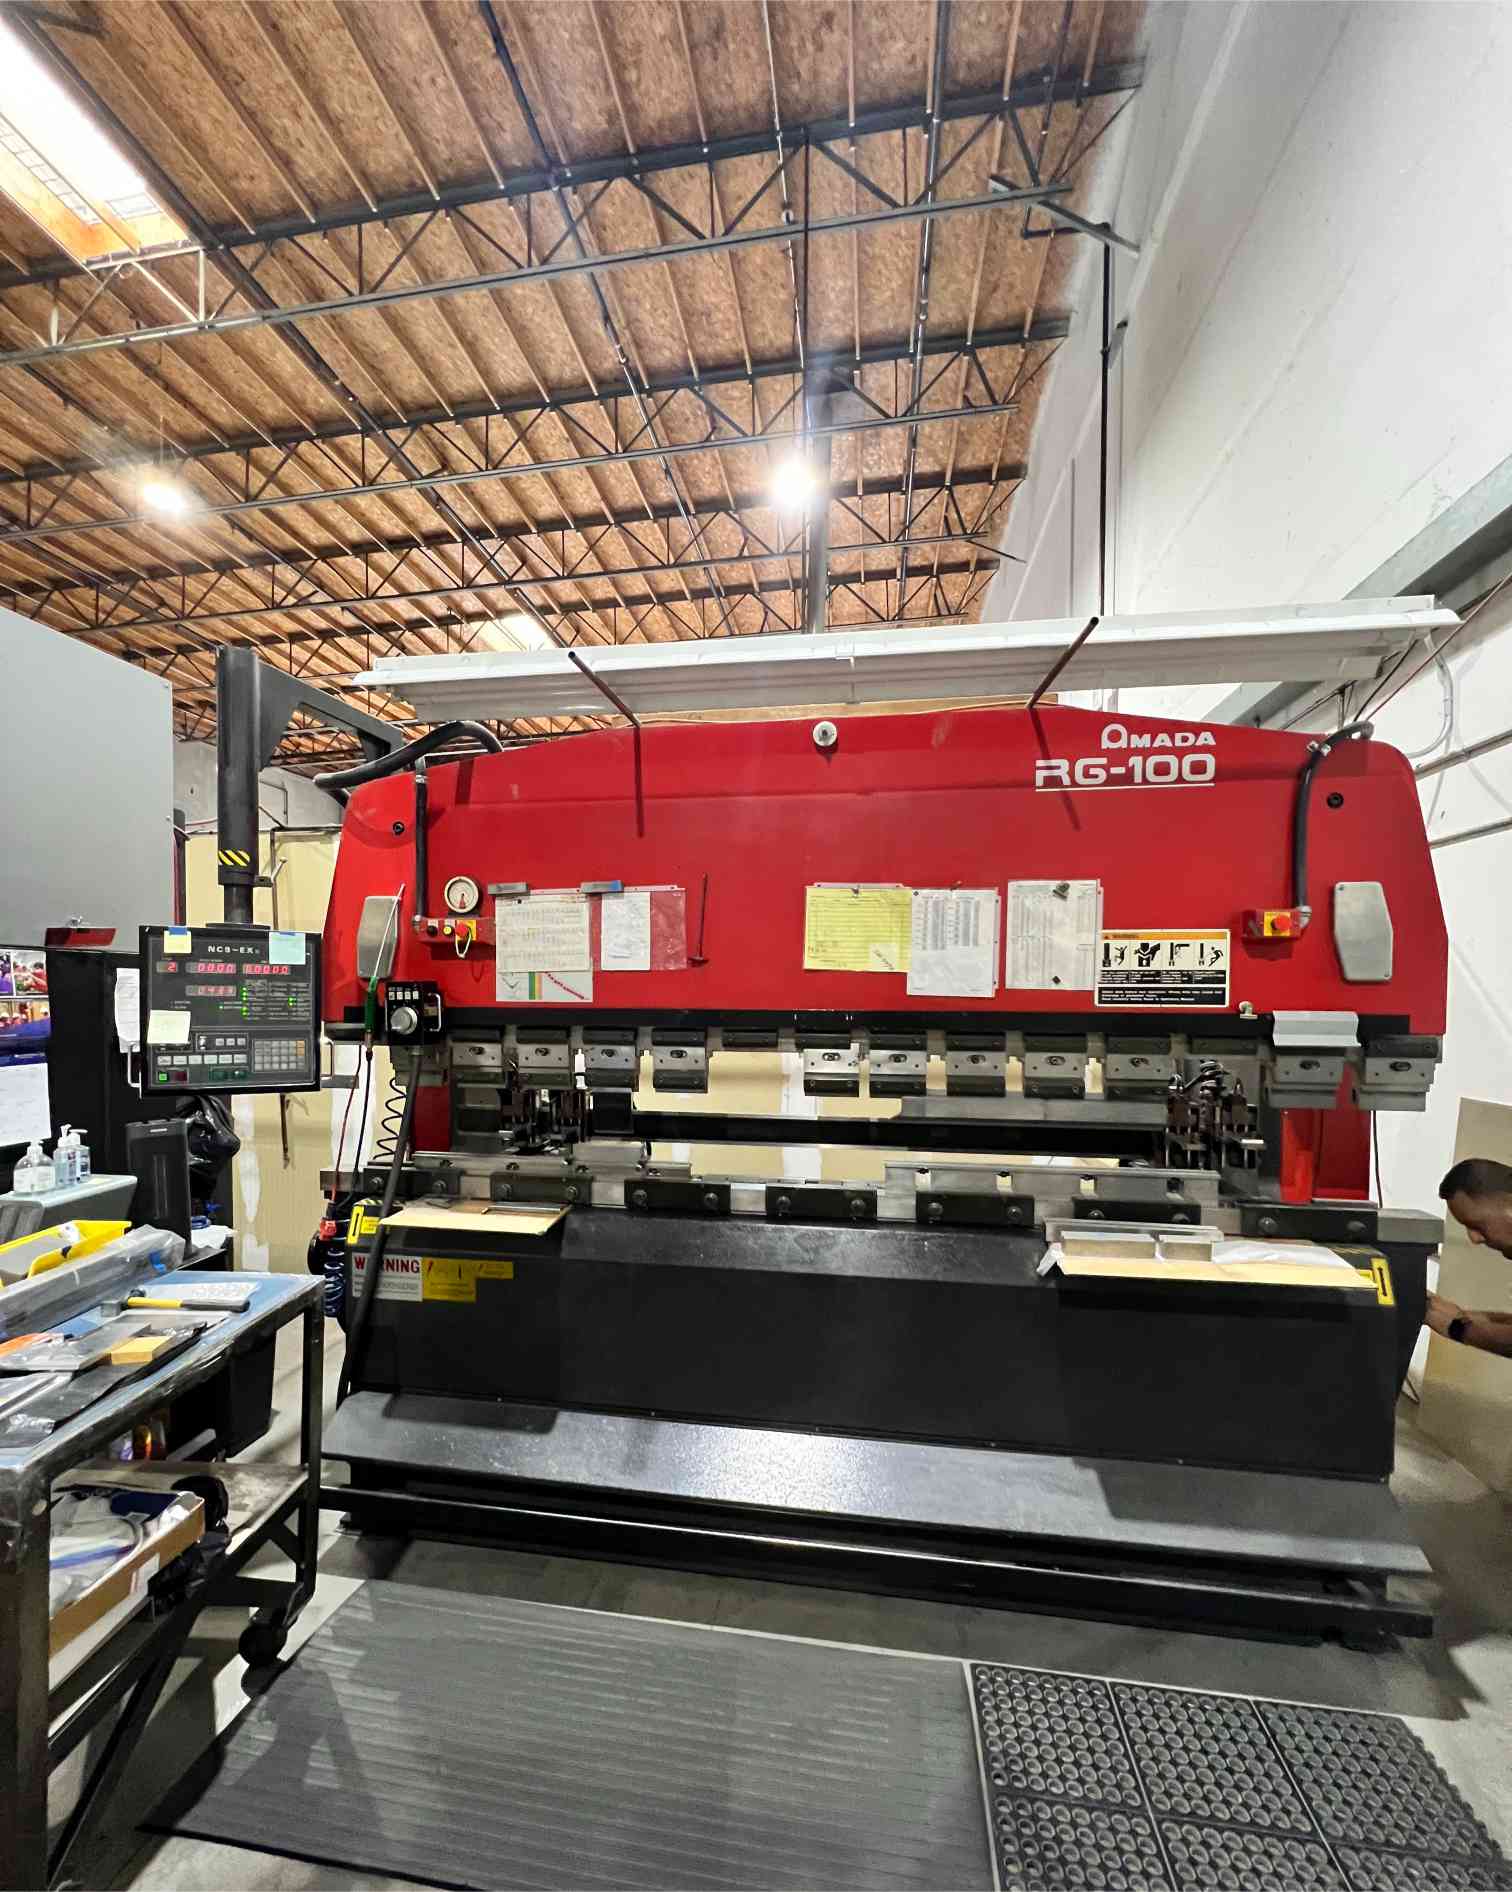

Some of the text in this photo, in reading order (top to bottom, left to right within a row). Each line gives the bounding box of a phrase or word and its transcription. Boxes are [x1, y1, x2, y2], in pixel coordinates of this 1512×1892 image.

[1101, 723, 1216, 749] AMADA
[1035, 753, 1216, 787] RG-100
[354, 1255, 420, 1274] WNING
